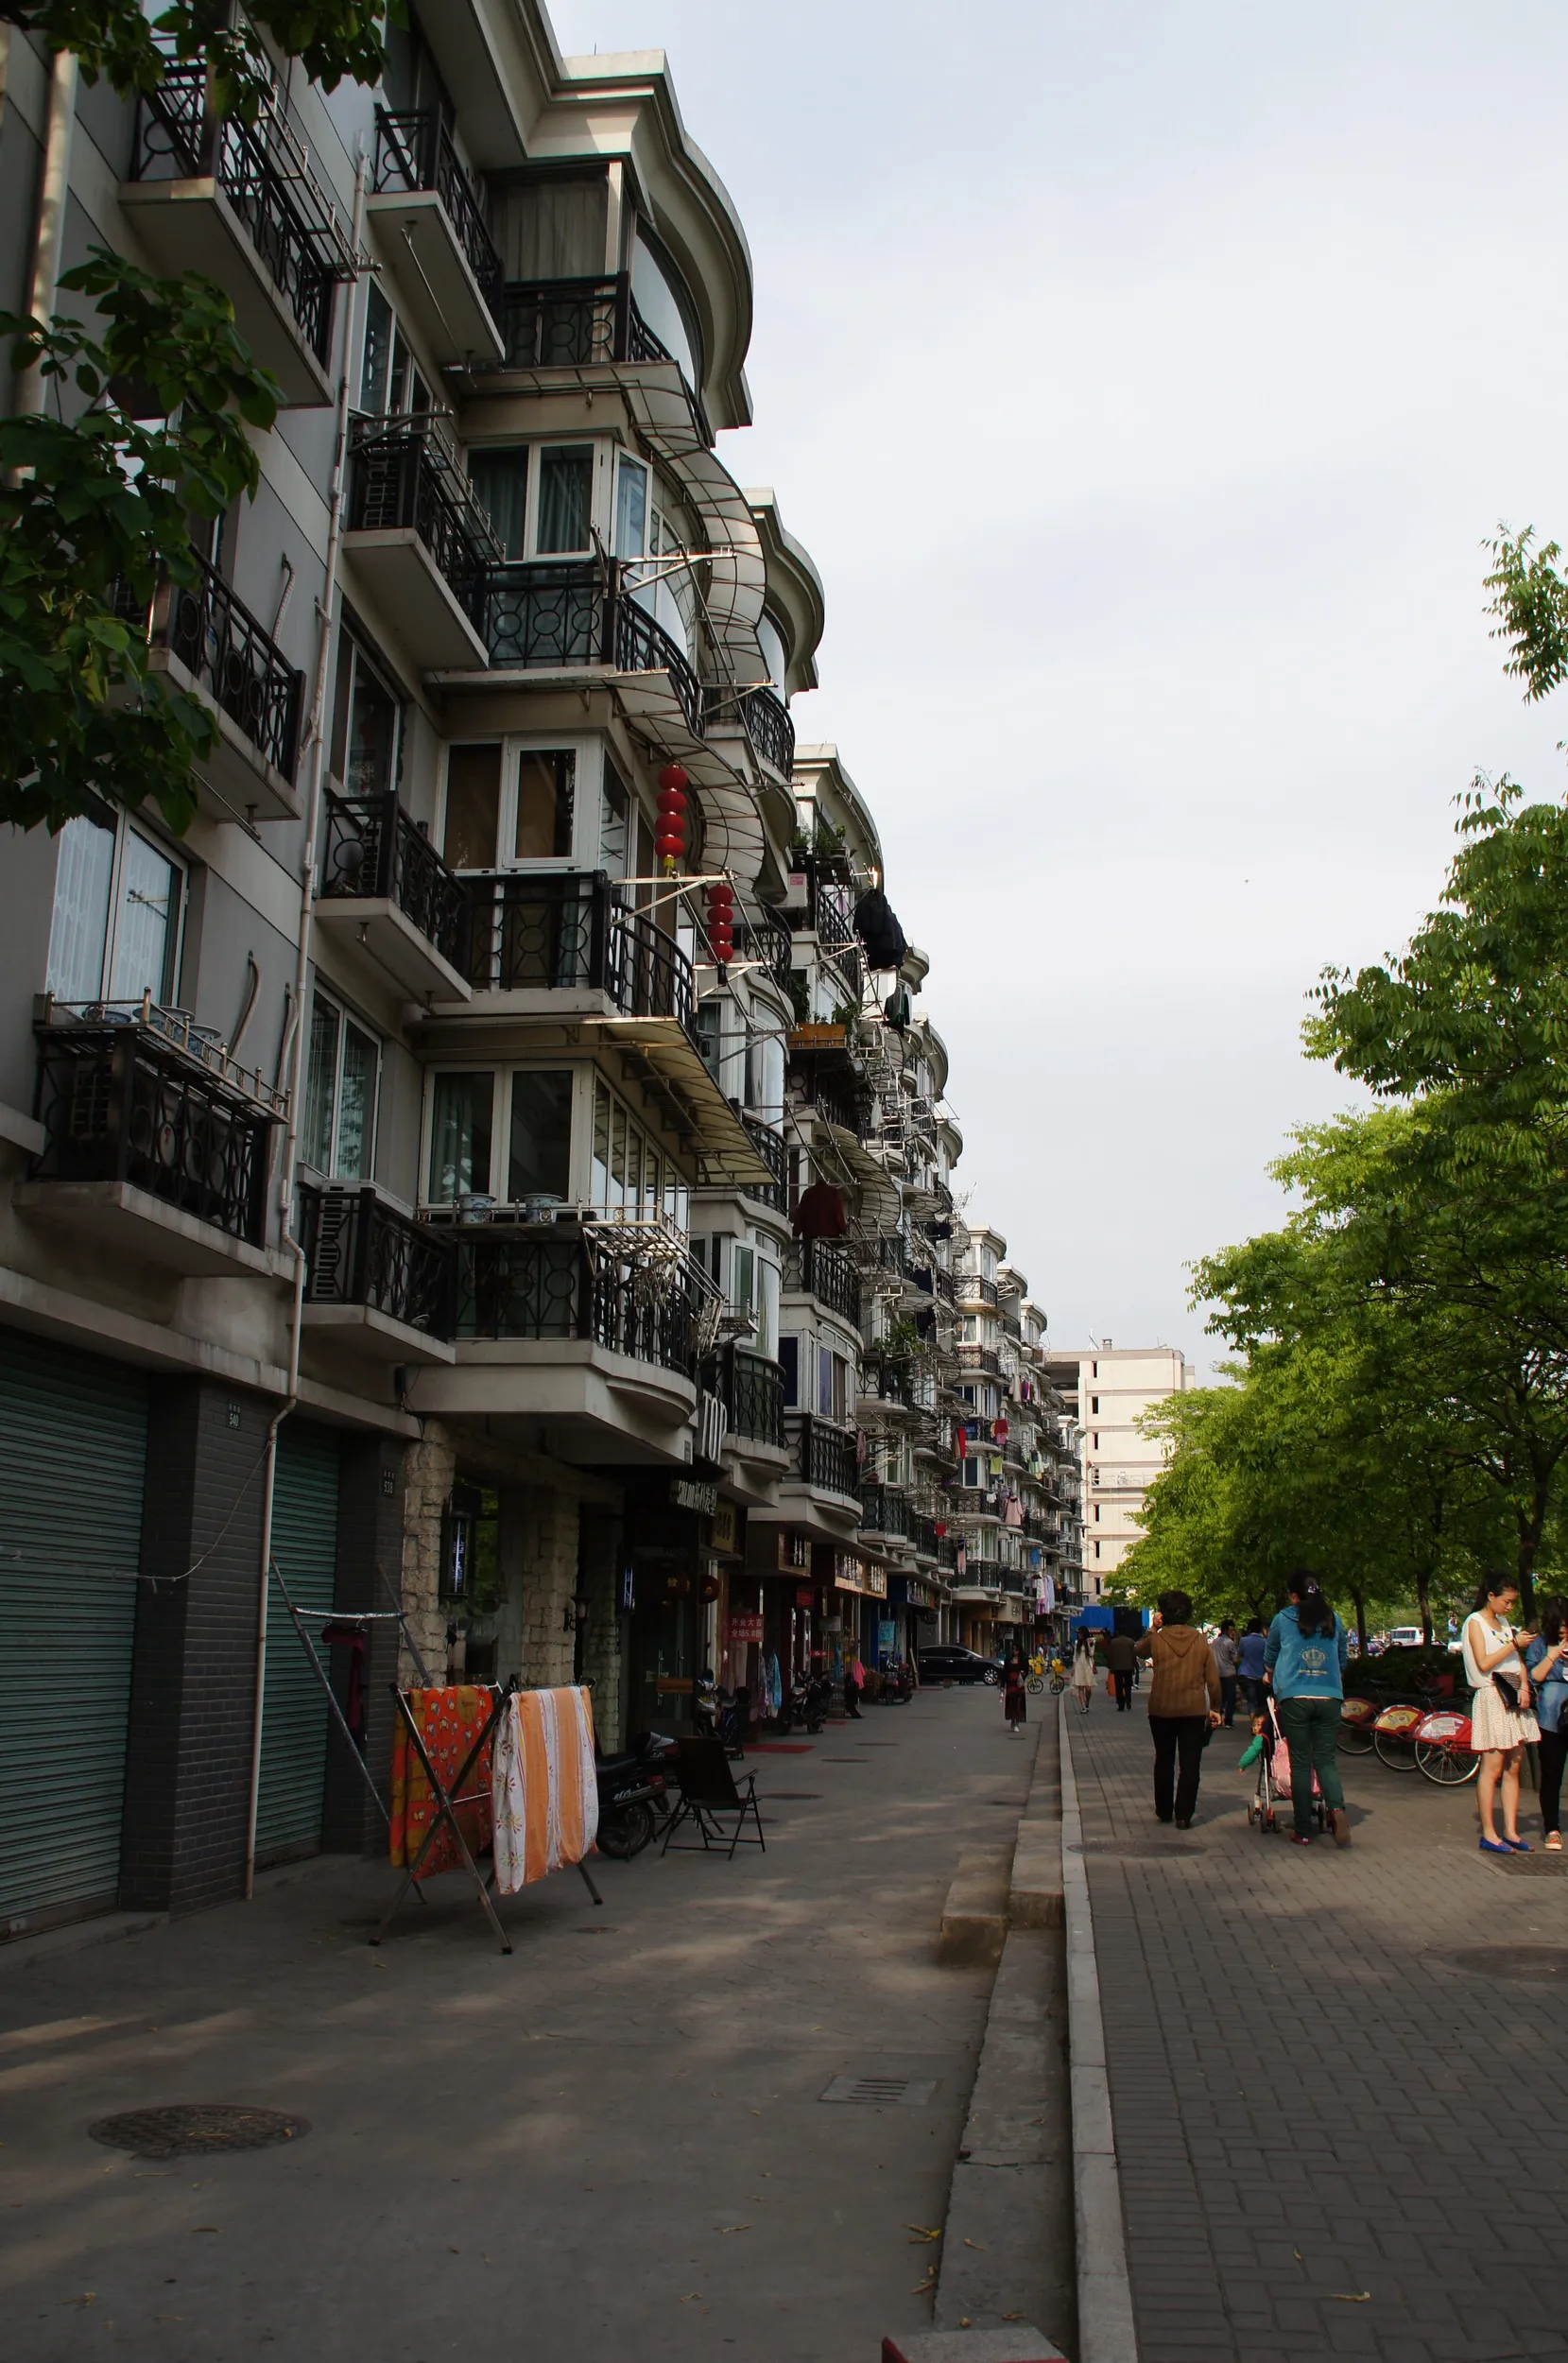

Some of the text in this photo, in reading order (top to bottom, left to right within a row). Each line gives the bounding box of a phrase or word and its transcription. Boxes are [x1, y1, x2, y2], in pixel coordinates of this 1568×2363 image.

[229, 1412, 239, 1427] 540
[700, 1388, 728, 1465] TOP
[731, 1617, 763, 1627] 开业大吉
